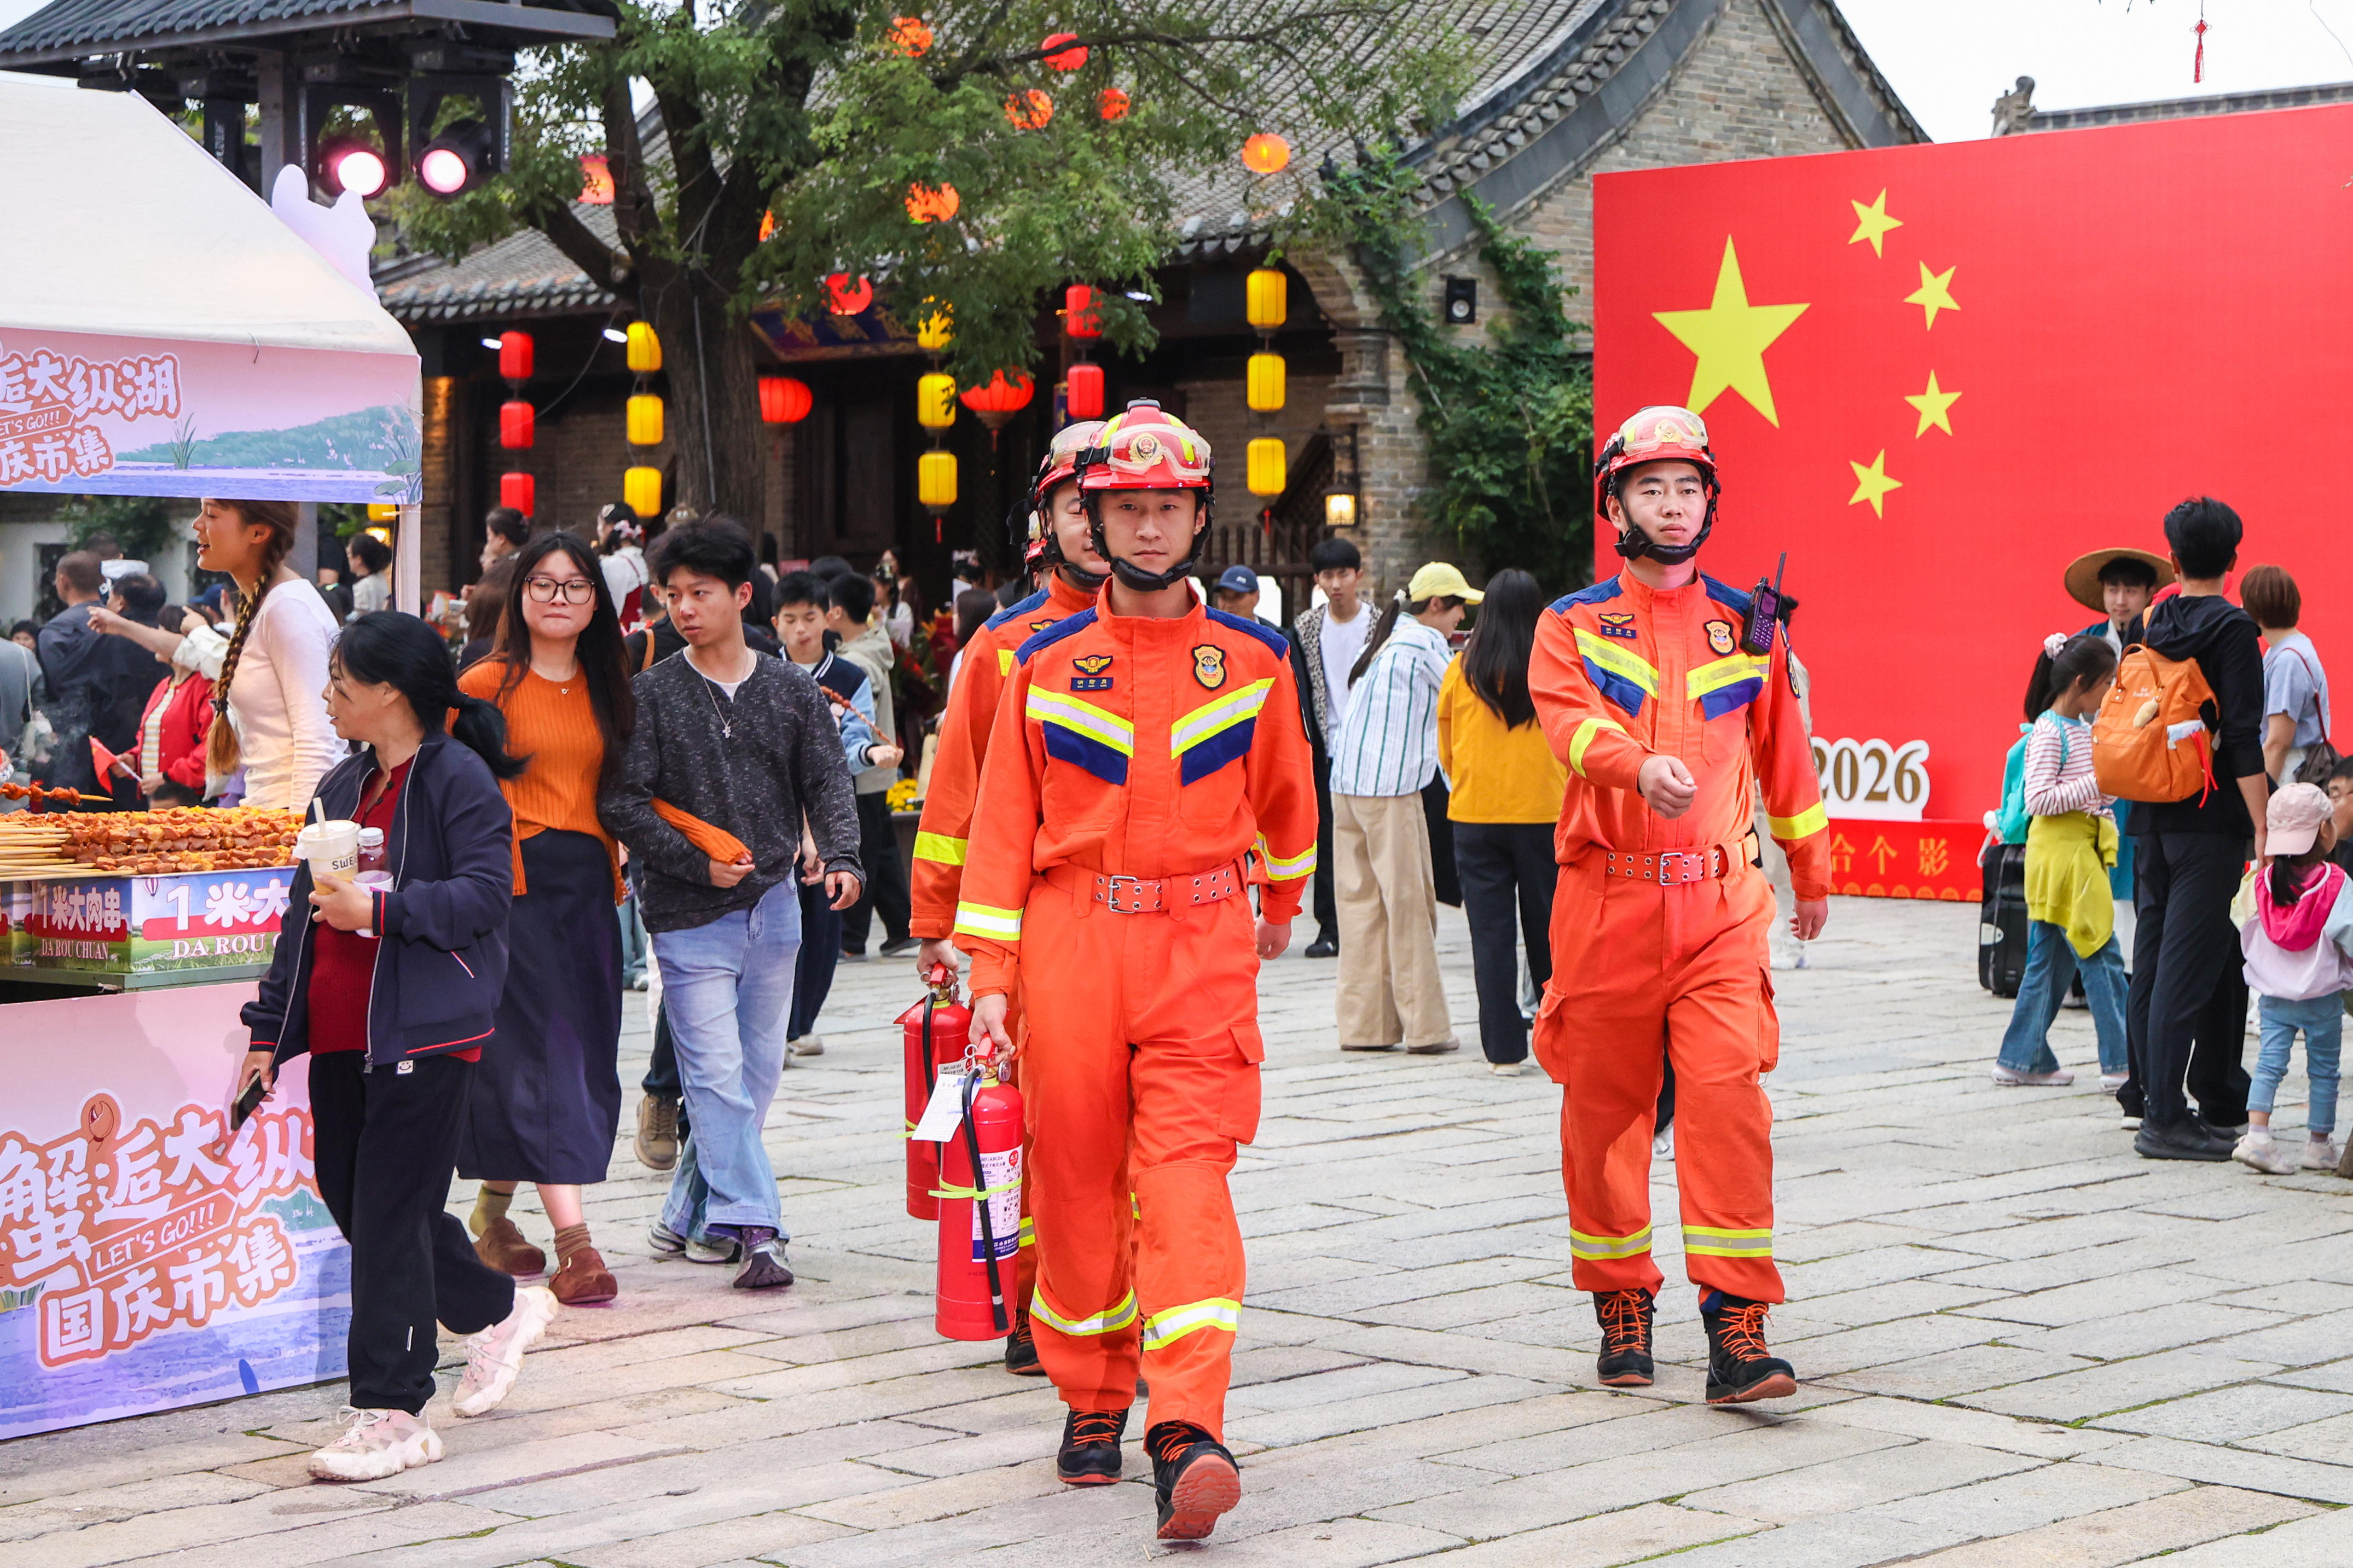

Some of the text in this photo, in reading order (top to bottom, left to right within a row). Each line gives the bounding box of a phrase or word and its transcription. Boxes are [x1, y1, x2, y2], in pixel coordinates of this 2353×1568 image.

[26, 410, 61, 430] GO!!!
[1830, 832, 1949, 876] 合个影
[40, 885, 121, 933] 1米大肉串
[42, 938, 109, 960] DA ROU CHUAN
[172, 938, 209, 958] DA
[214, 933, 266, 955] ROU
[96, 1203, 216, 1273] LET'S GO!!!
[47, 1224, 289, 1360] 国庆市集
